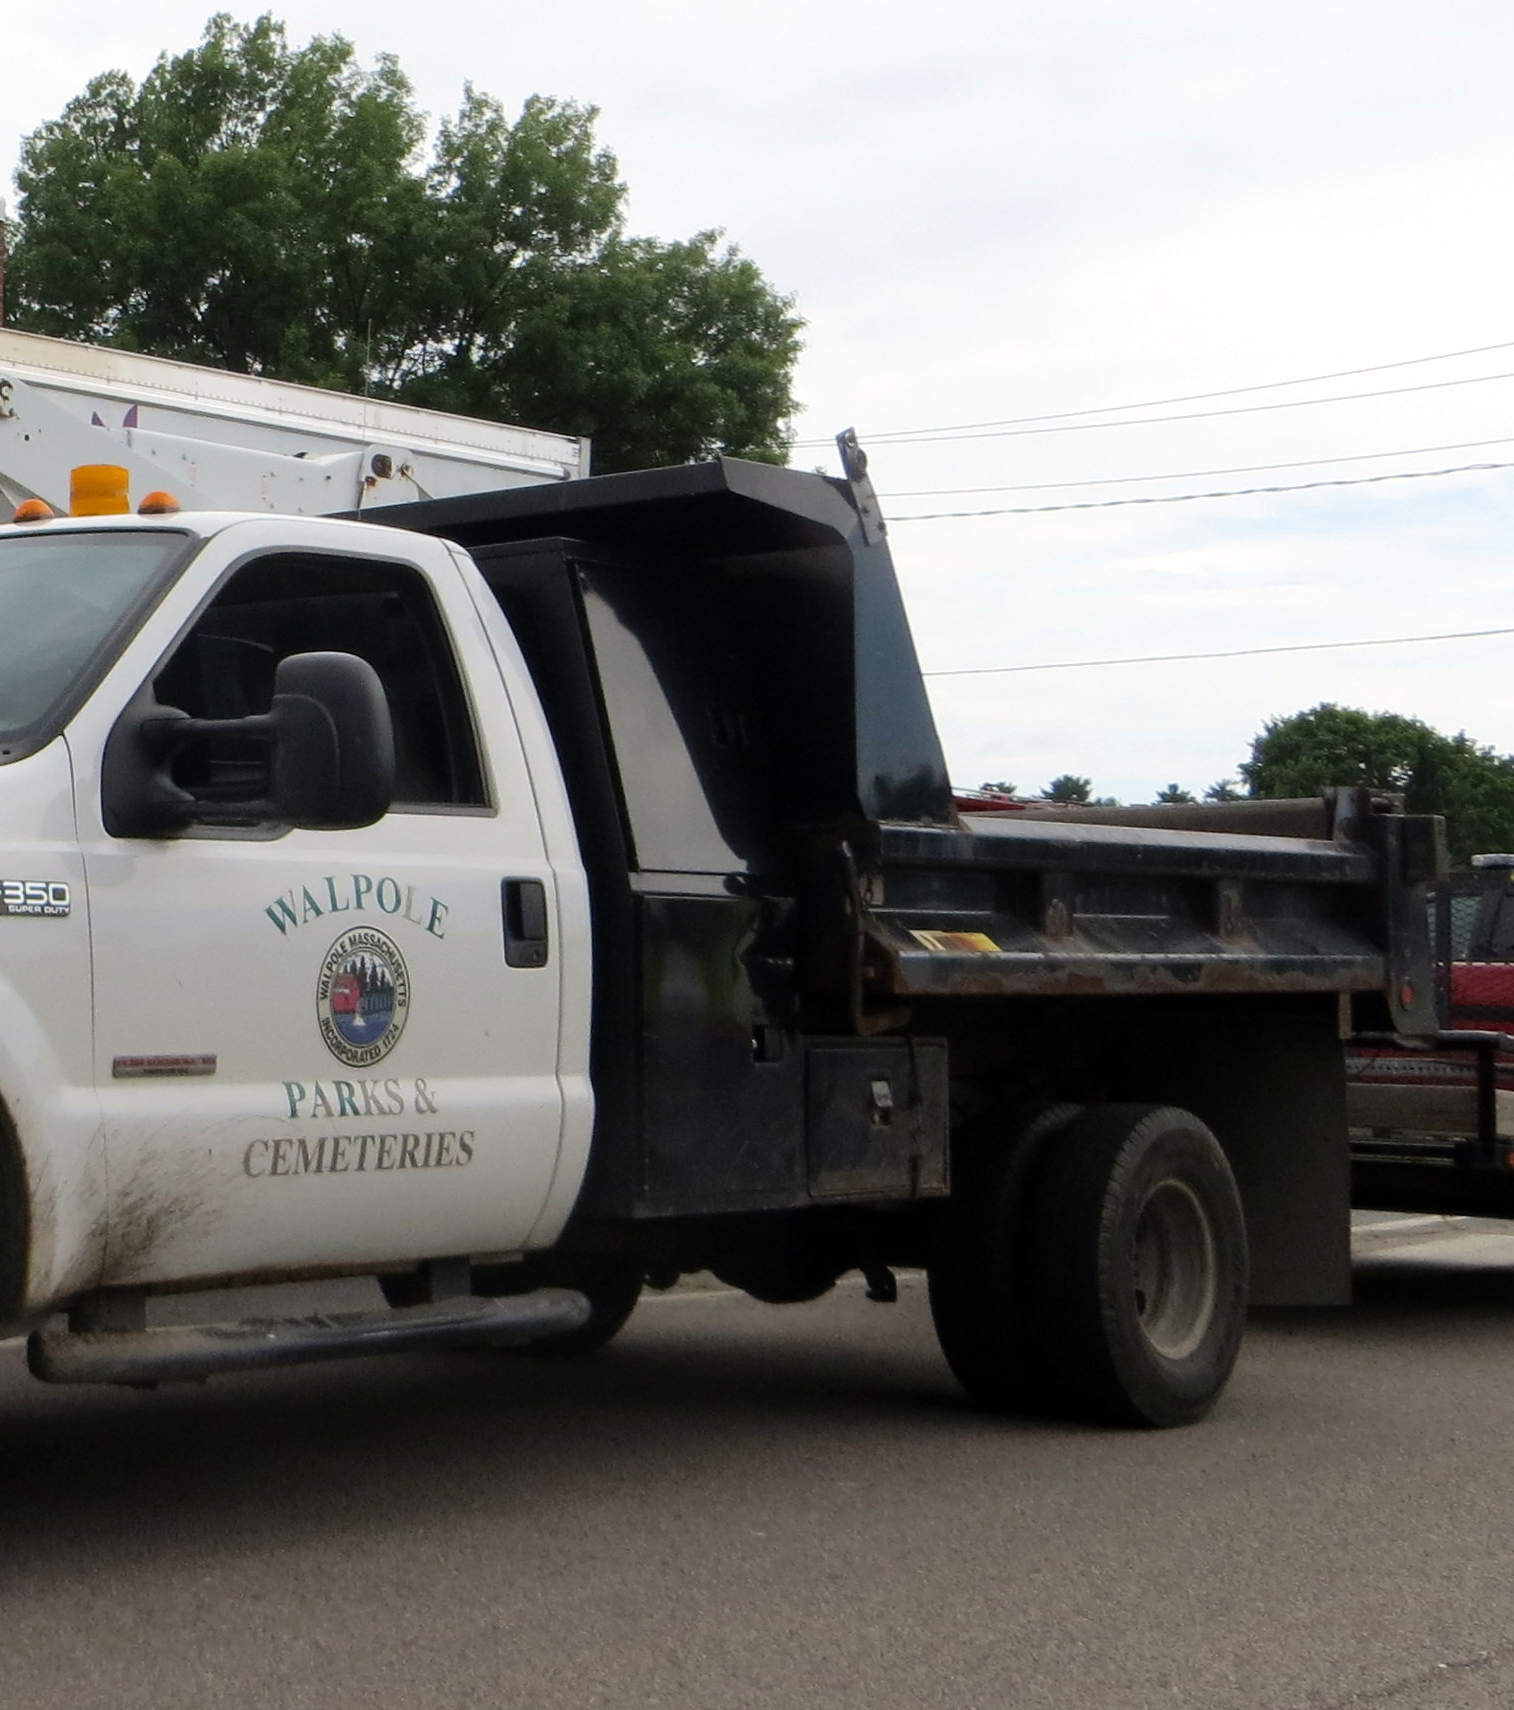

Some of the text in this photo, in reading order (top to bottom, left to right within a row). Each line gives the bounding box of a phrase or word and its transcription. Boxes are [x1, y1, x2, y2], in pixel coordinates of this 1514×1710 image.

[7, 905, 70, 914] SUPER DUTY
[264, 873, 450, 940] WALPOLE
[319, 933, 407, 1008] WALPOLE MASSACHUSETTS
[321, 1016, 400, 1063] INCORPORATED 1724
[282, 1077, 439, 1119] PARKS &
[242, 1129, 476, 1178] CEMETERIES
